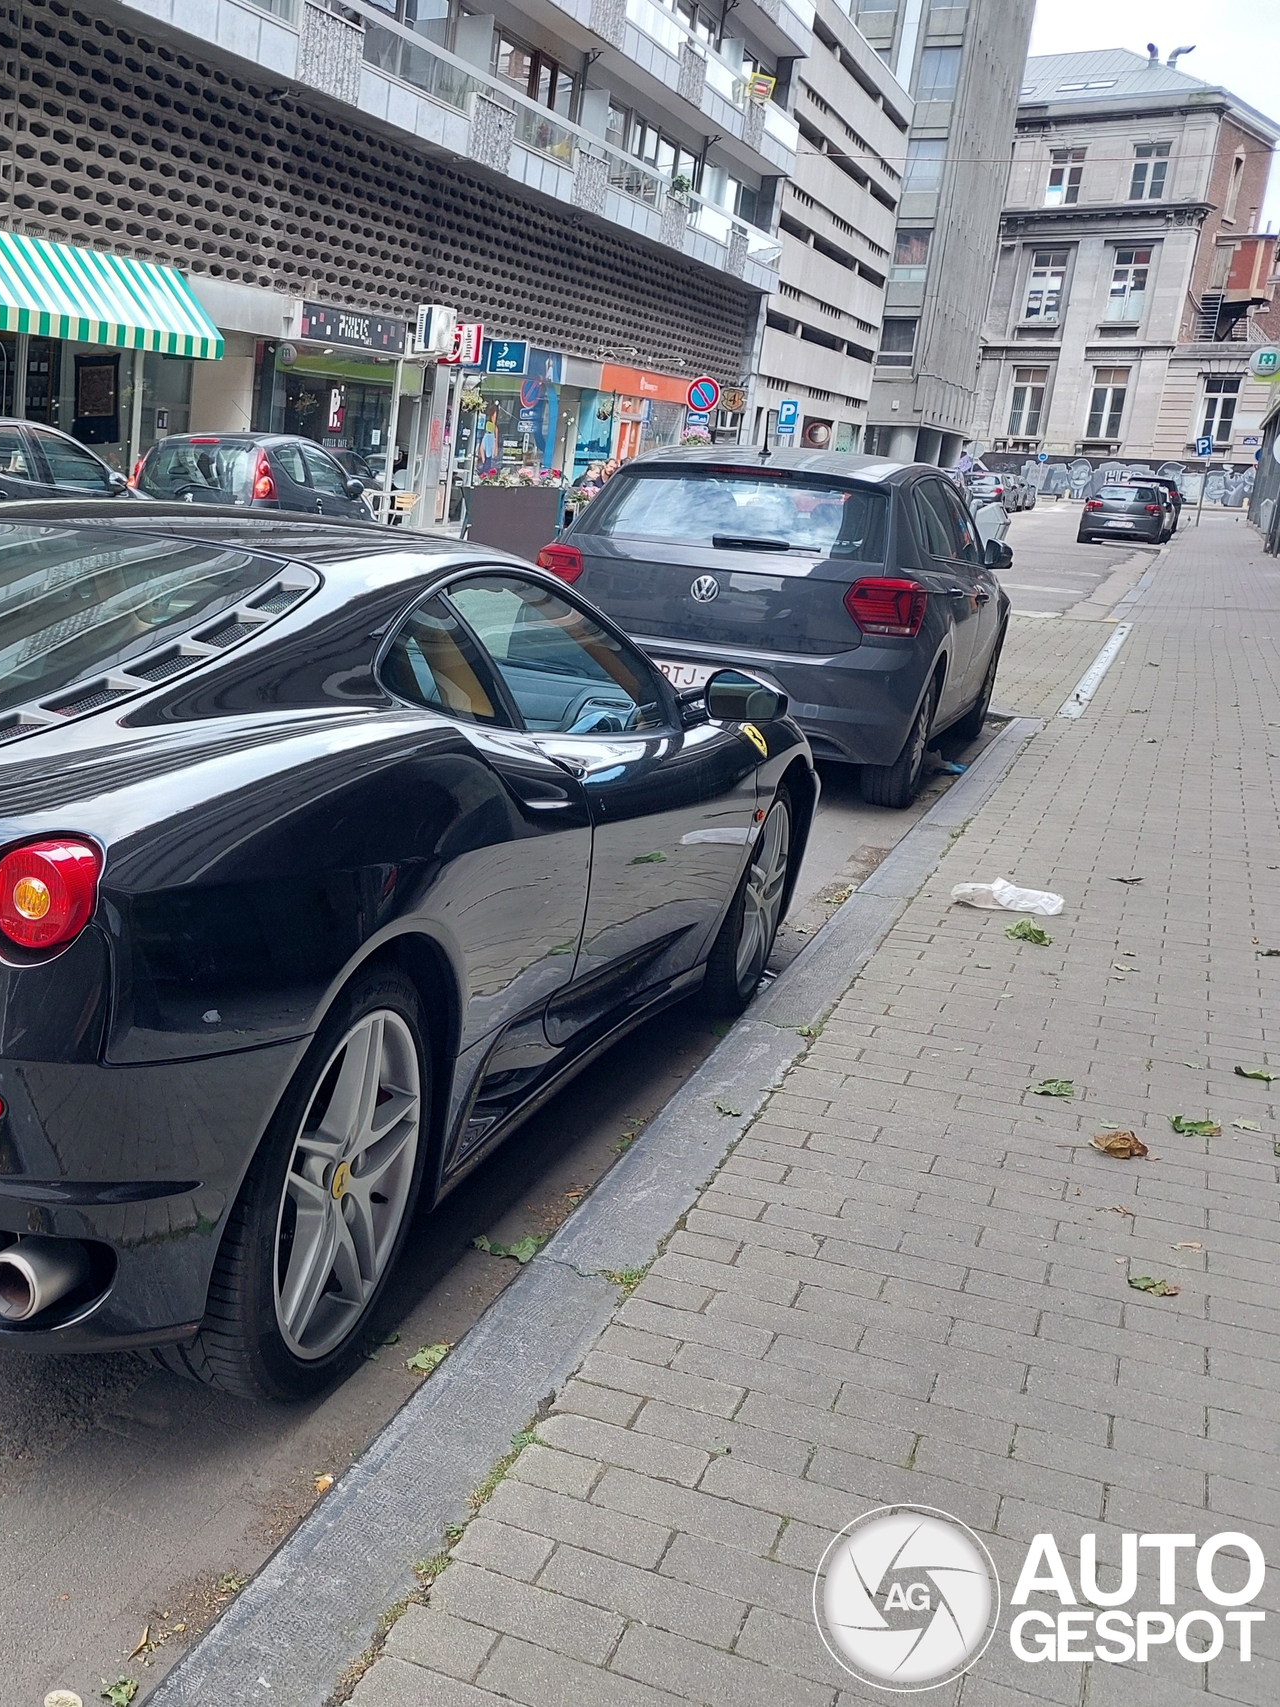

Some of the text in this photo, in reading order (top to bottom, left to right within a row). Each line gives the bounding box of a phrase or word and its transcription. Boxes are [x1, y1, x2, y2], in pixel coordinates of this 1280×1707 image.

[463, 327, 472, 360] Jupiler
[496, 359, 517, 369] step
[780, 403, 796, 422] P
[1198, 440, 1209, 453] P
